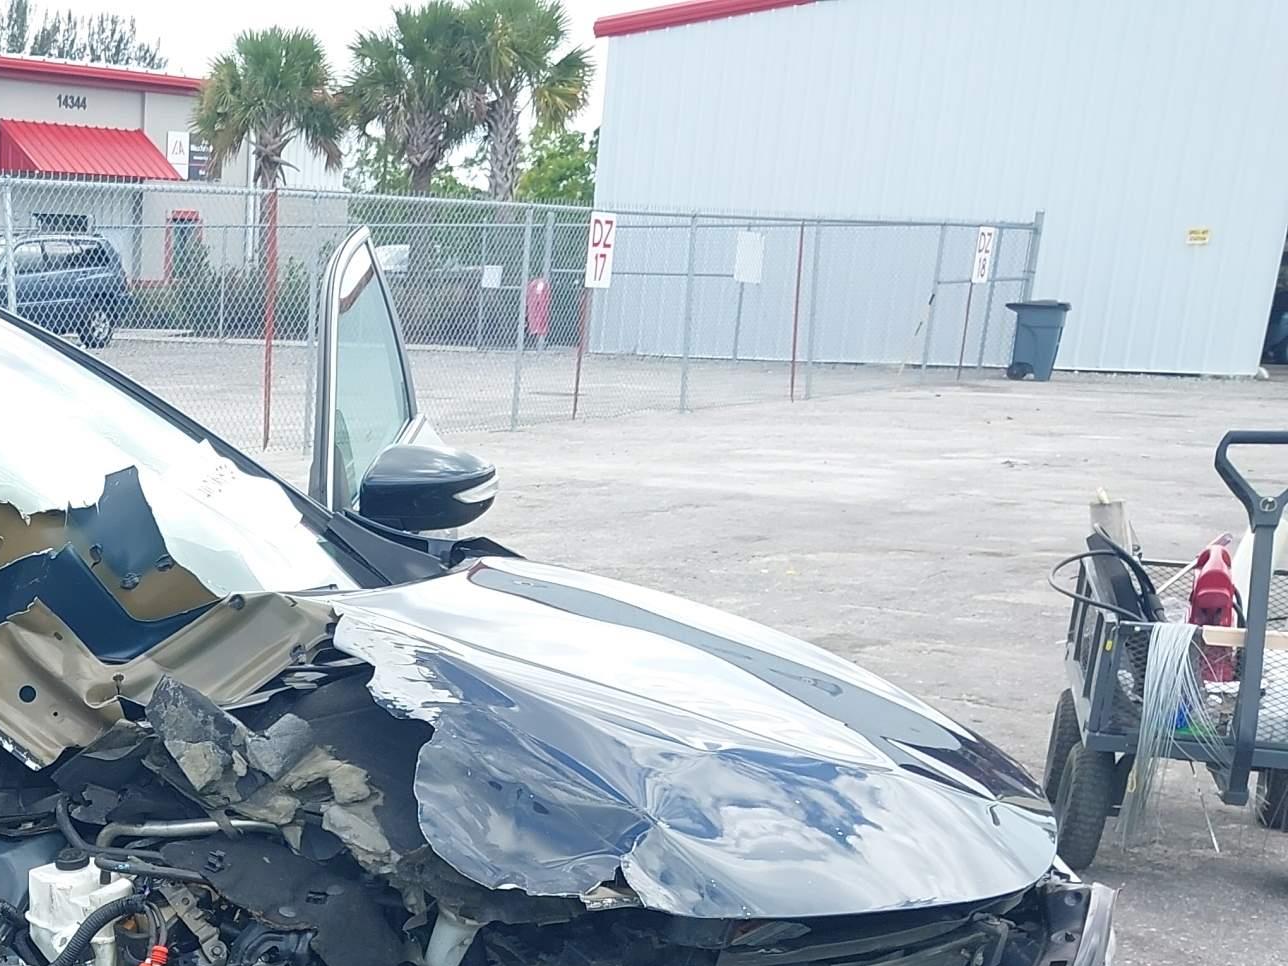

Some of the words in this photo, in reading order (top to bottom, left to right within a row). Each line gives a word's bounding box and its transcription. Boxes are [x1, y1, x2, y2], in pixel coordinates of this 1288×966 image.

[56, 94, 88, 111] 14344
[592, 219, 614, 248] DZ
[978, 232, 993, 253] DZ
[593, 253, 607, 281] 17
